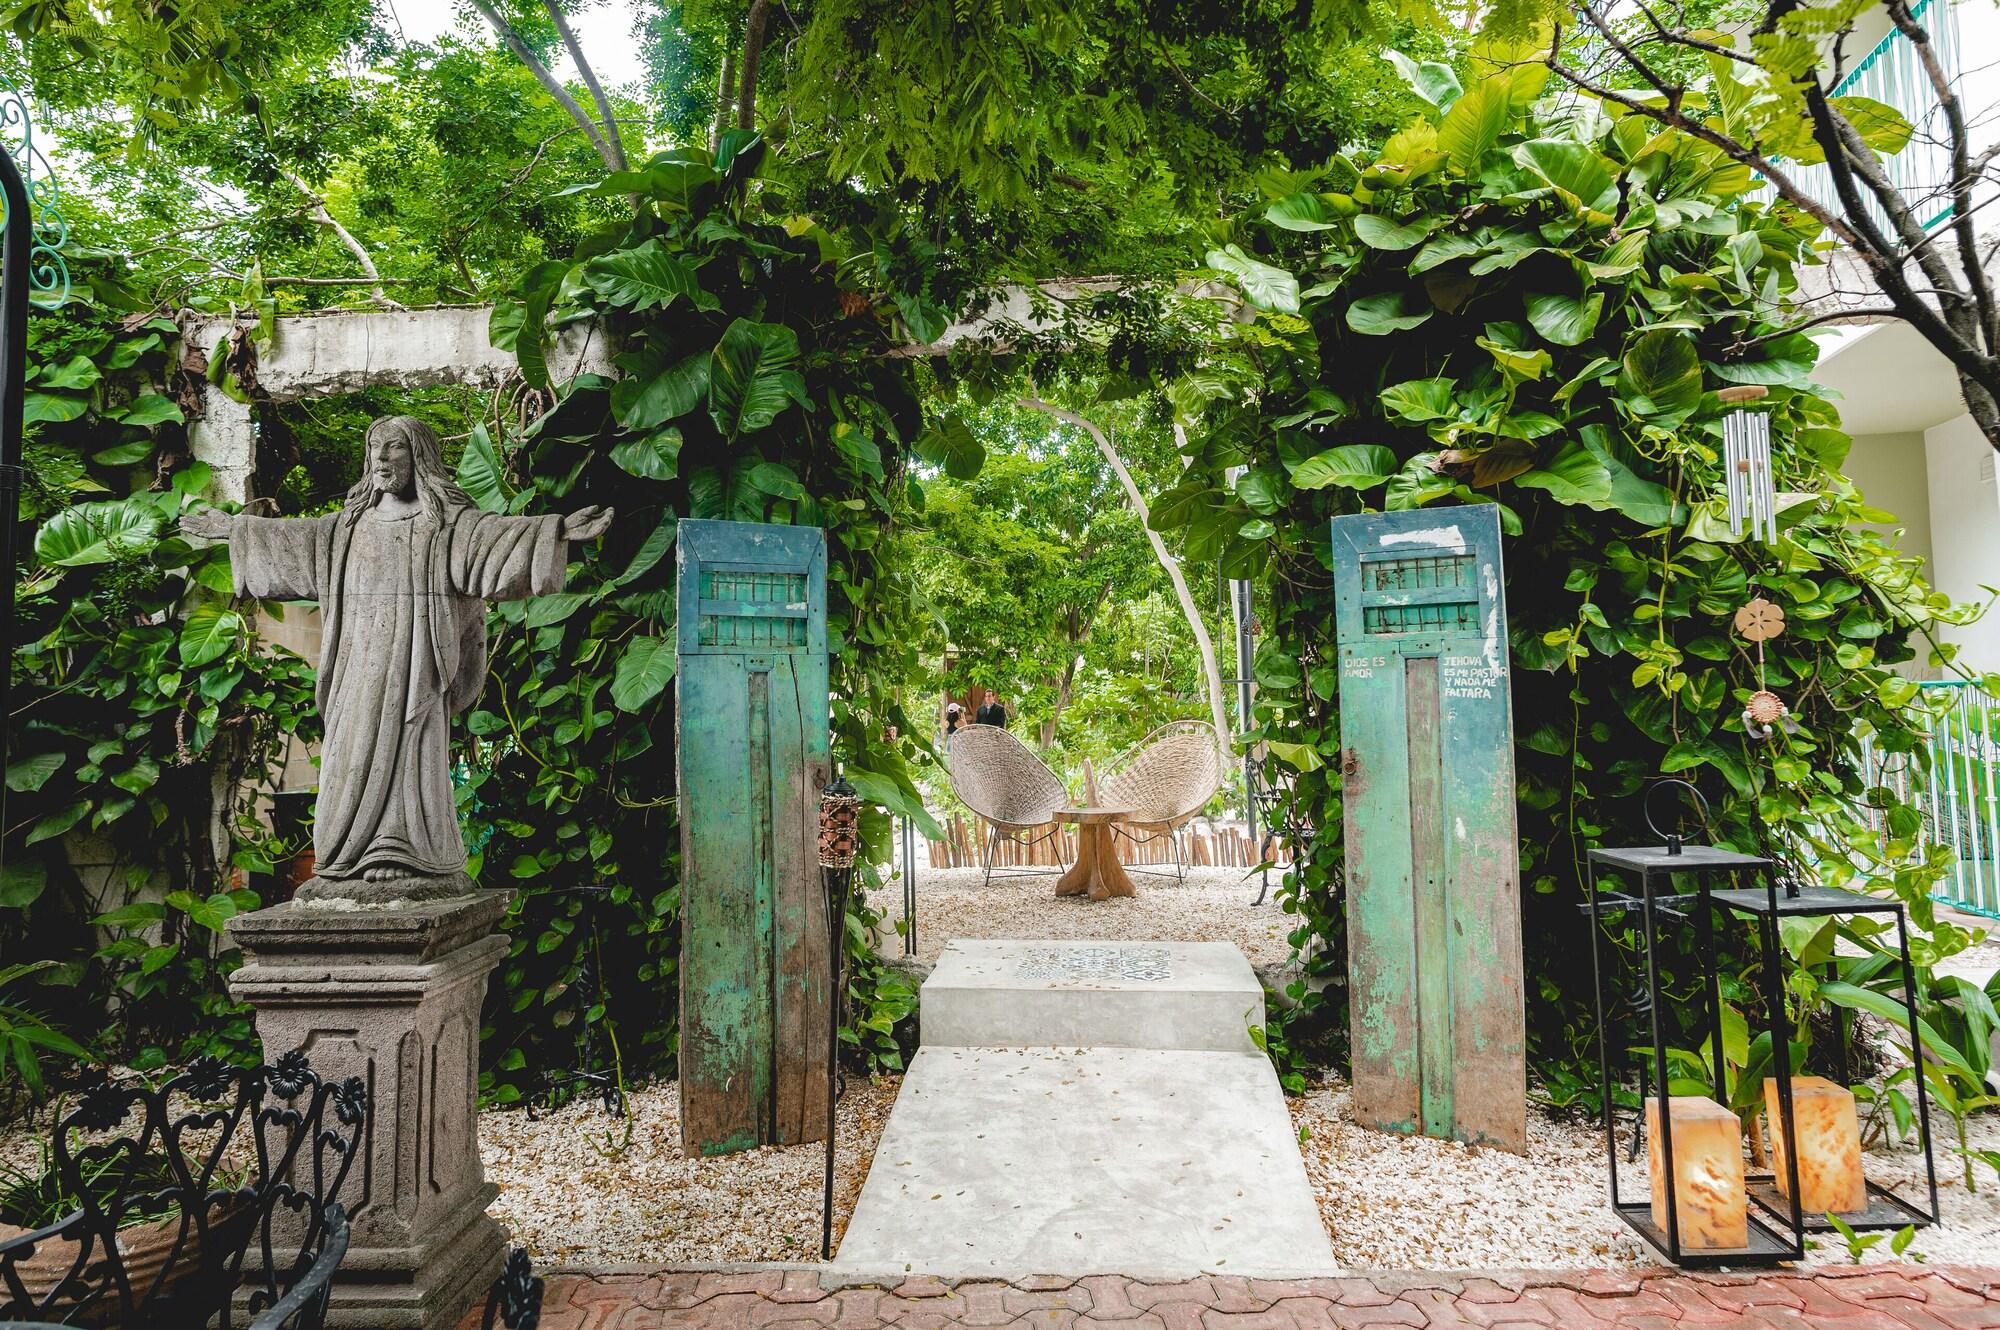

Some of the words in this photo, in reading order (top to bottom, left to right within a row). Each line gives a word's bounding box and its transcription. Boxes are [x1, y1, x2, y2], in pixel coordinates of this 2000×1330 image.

[1345, 657, 1368, 668] DIOS
[1372, 656, 1385, 667] ES
[1443, 656, 1482, 666] JEHOVA
[1344, 668, 1373, 678] AMOR
[1444, 668, 1455, 676] ES
[1471, 667, 1507, 678] PASTOR
[1445, 677, 1451, 687] Y
[1454, 678, 1480, 686] NADA
[1482, 678, 1496, 687] ME
[1445, 687, 1491, 699] FALTARA
